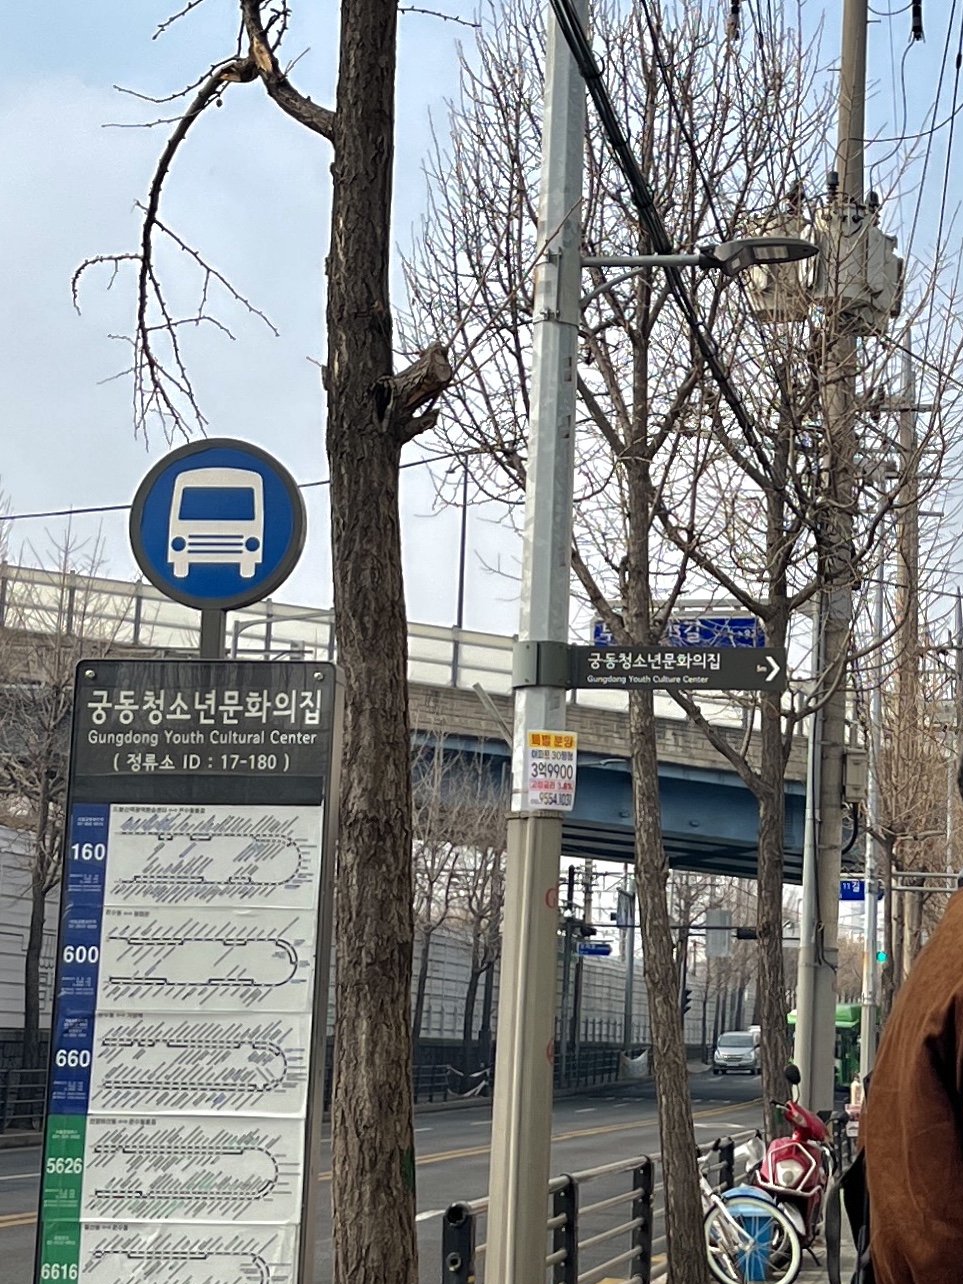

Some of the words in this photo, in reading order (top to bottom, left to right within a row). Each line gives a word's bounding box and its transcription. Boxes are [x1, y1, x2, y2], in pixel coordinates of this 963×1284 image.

[588, 653, 721, 670] 궁동청소년문화의집
[628, 675, 650, 683] Youth
[683, 676, 709, 684] Center
[87, 690, 322, 725] 궁동청소년문화의집
[88, 730, 159, 747] Gungdong
[165, 730, 204, 745] Youth
[210, 730, 265, 745] Cultural
[270, 730, 317, 745] Center
[126, 753, 175, 771] 정류소
[183, 754, 200, 769] ID
[221, 754, 277, 769] 17-180
[531, 762, 573, 779] 3억9900
[72, 843, 105, 860] 160
[63, 945, 99, 964] 600
[55, 1049, 90, 1067] 660
[46, 1158, 82, 1175] 5626
[41, 1263, 77, 1280] 6616
